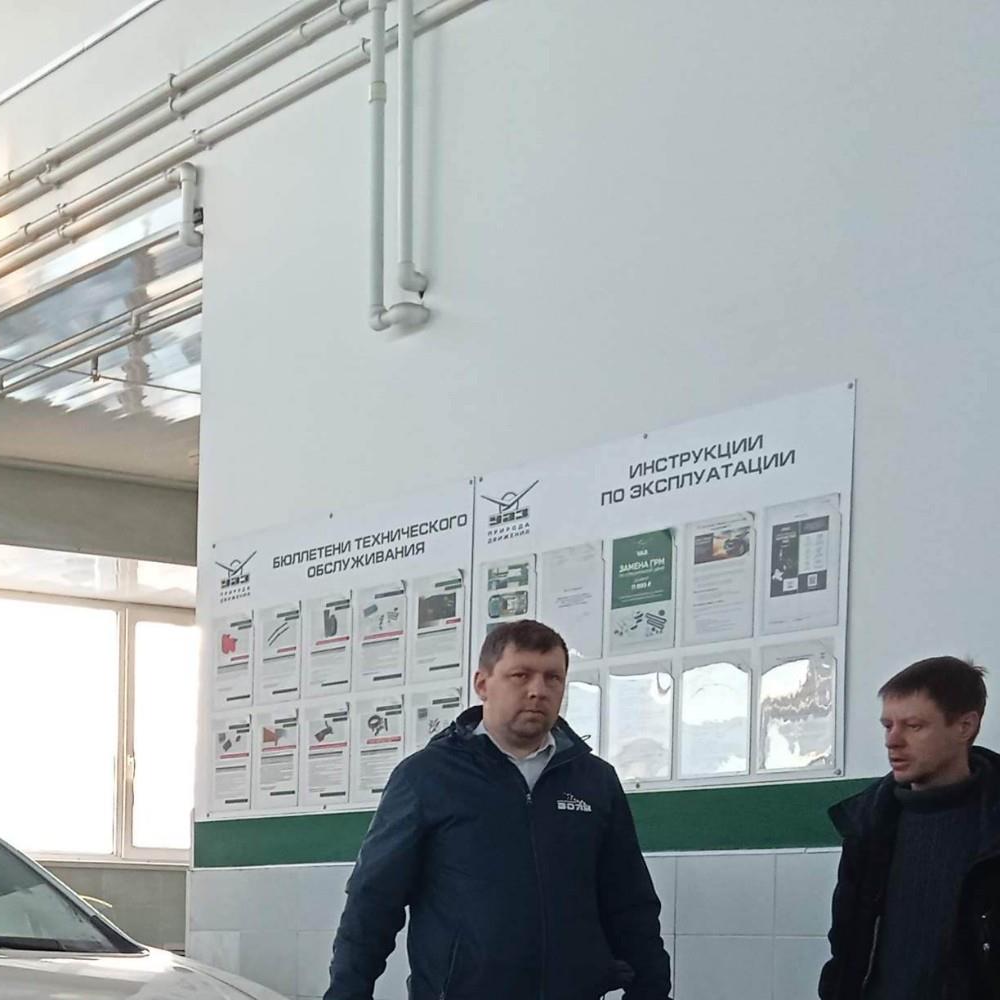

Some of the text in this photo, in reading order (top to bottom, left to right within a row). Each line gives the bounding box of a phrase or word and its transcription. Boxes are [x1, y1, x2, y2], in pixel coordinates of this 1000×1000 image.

[601, 449, 796, 506] ПО ЭКСПЛУАТАЦИИ
[629, 434, 763, 479] ИНСТРУКЦИИ
[272, 513, 468, 569] БЮЛЛЕТЕНИ ТЕХНИЧЕСКОГО
[307, 541, 425, 579] ОБСЛУЖИВАНИЯ
